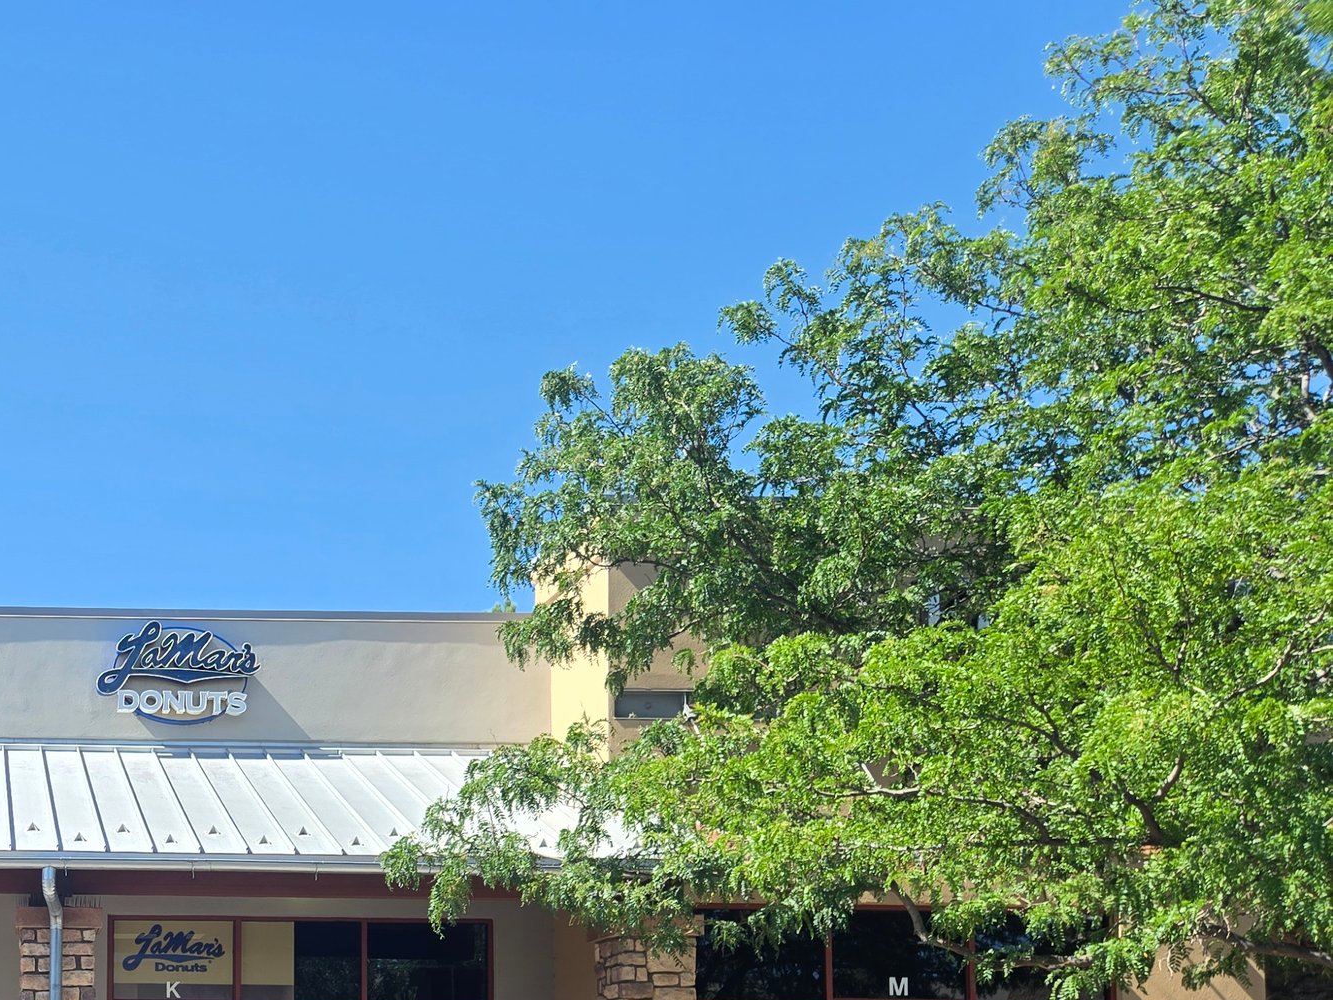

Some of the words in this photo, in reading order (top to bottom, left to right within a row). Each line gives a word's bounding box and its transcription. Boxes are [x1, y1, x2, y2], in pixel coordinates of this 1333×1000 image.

[96, 620, 261, 696] LaMar's
[116, 689, 248, 717] DONUTS
[122, 924, 225, 971] LaMar's
[155, 962, 208, 972] Donuts
[166, 981, 181, 998] K
[889, 976, 908, 996] M
